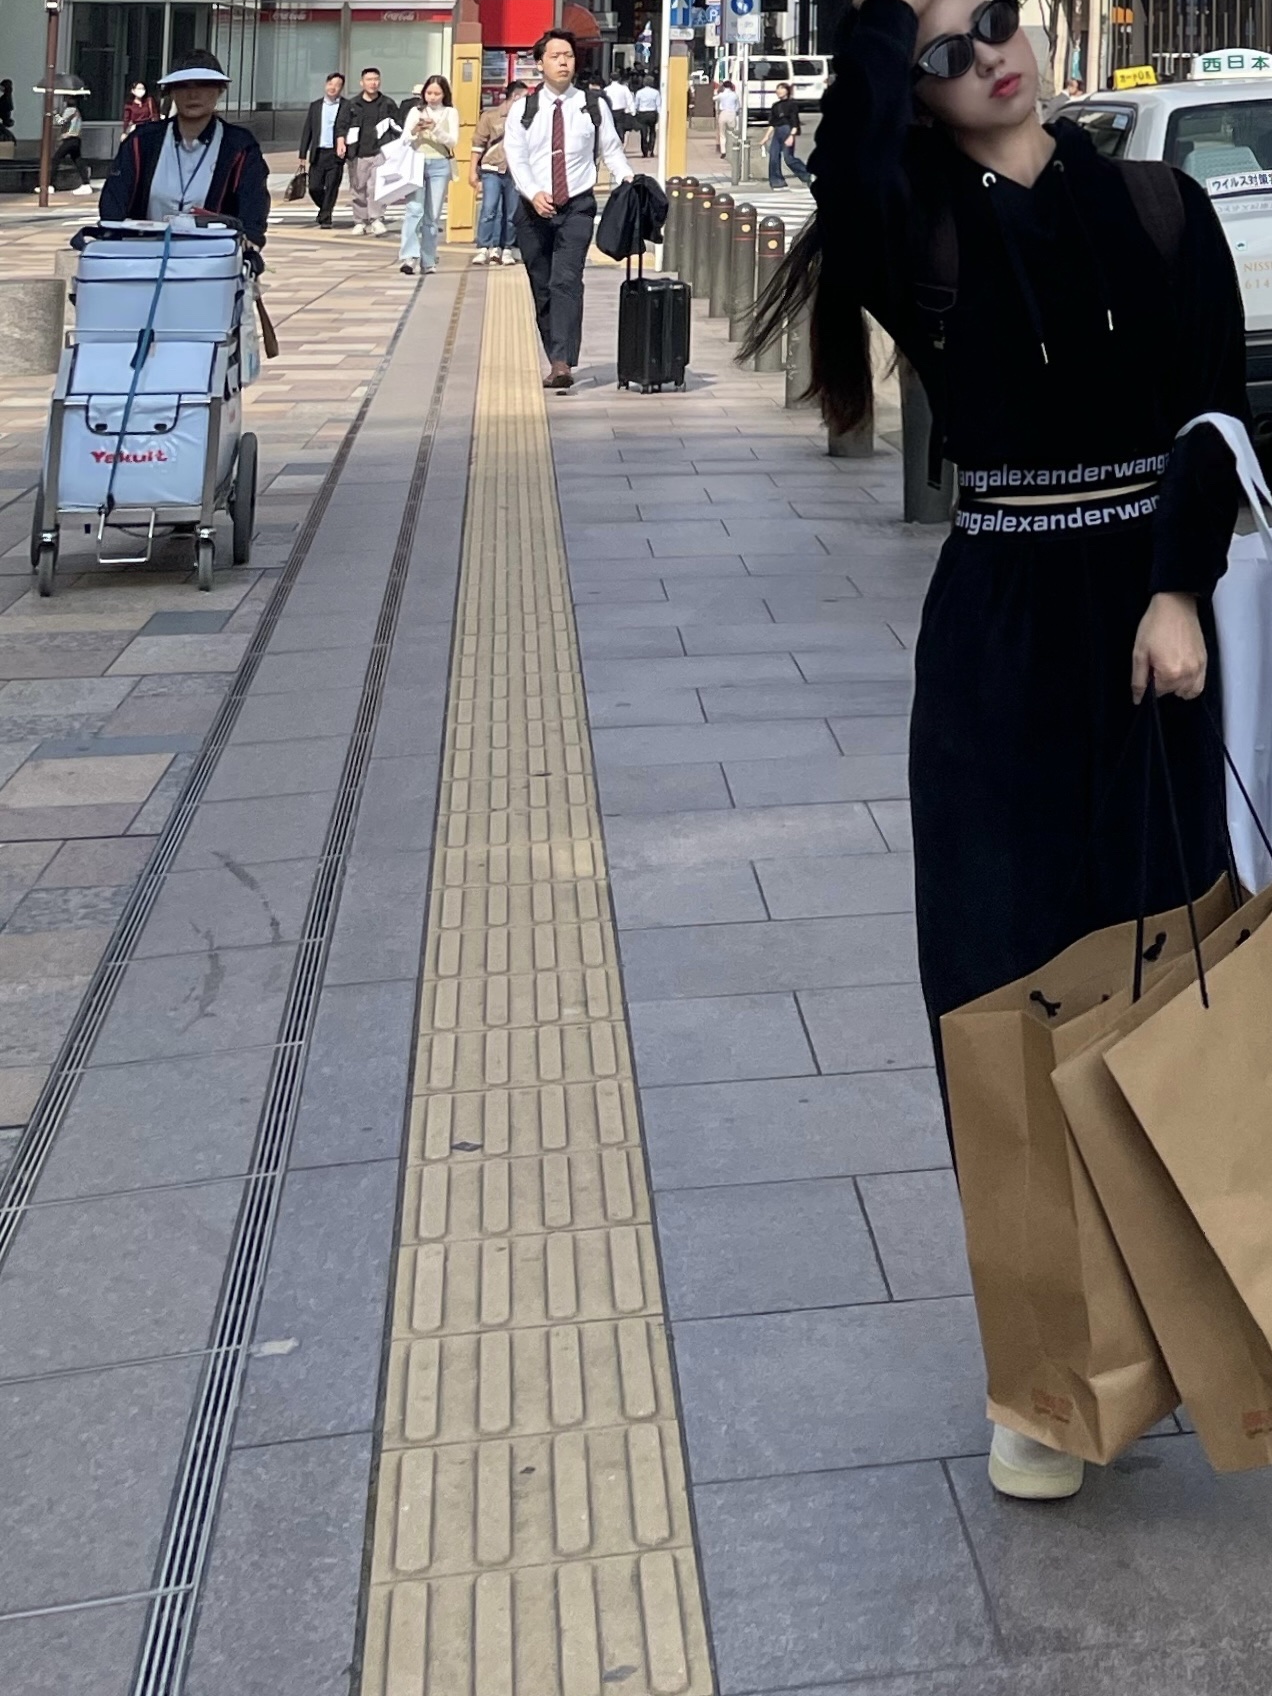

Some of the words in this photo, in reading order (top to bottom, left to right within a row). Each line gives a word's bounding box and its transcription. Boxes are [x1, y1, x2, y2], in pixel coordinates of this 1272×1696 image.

[1203, 56, 1271, 73] 西日本
[1244, 279, 1271, 290] 614
[90, 450, 169, 464] Yakult
